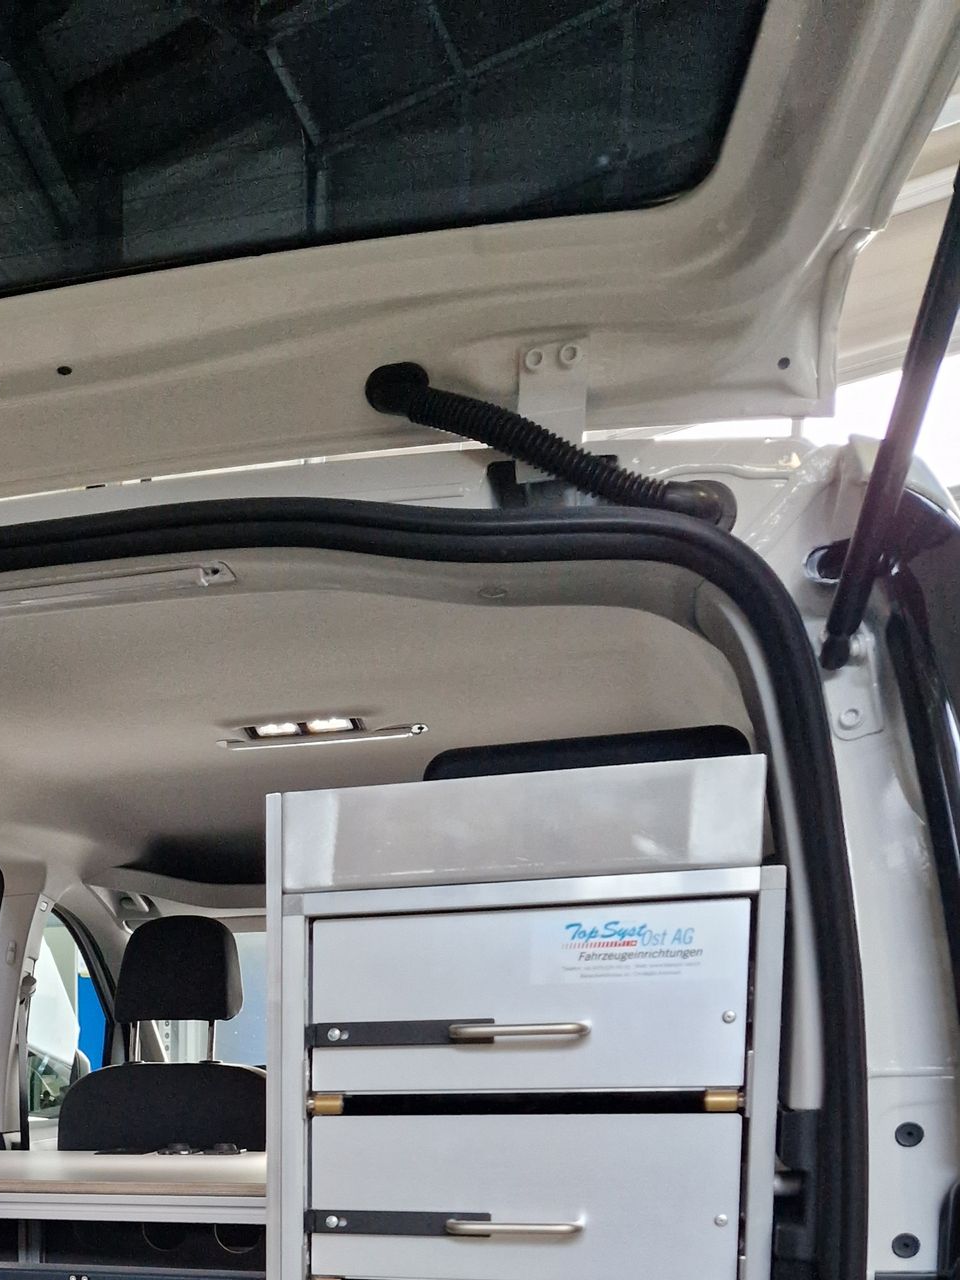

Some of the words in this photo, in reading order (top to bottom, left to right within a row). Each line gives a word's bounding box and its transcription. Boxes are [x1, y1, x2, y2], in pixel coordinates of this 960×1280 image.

[641, 929, 668, 947] Ost
[672, 927, 696, 946] AG
[578, 948, 704, 962] Fahrzeugeinrichtungen
